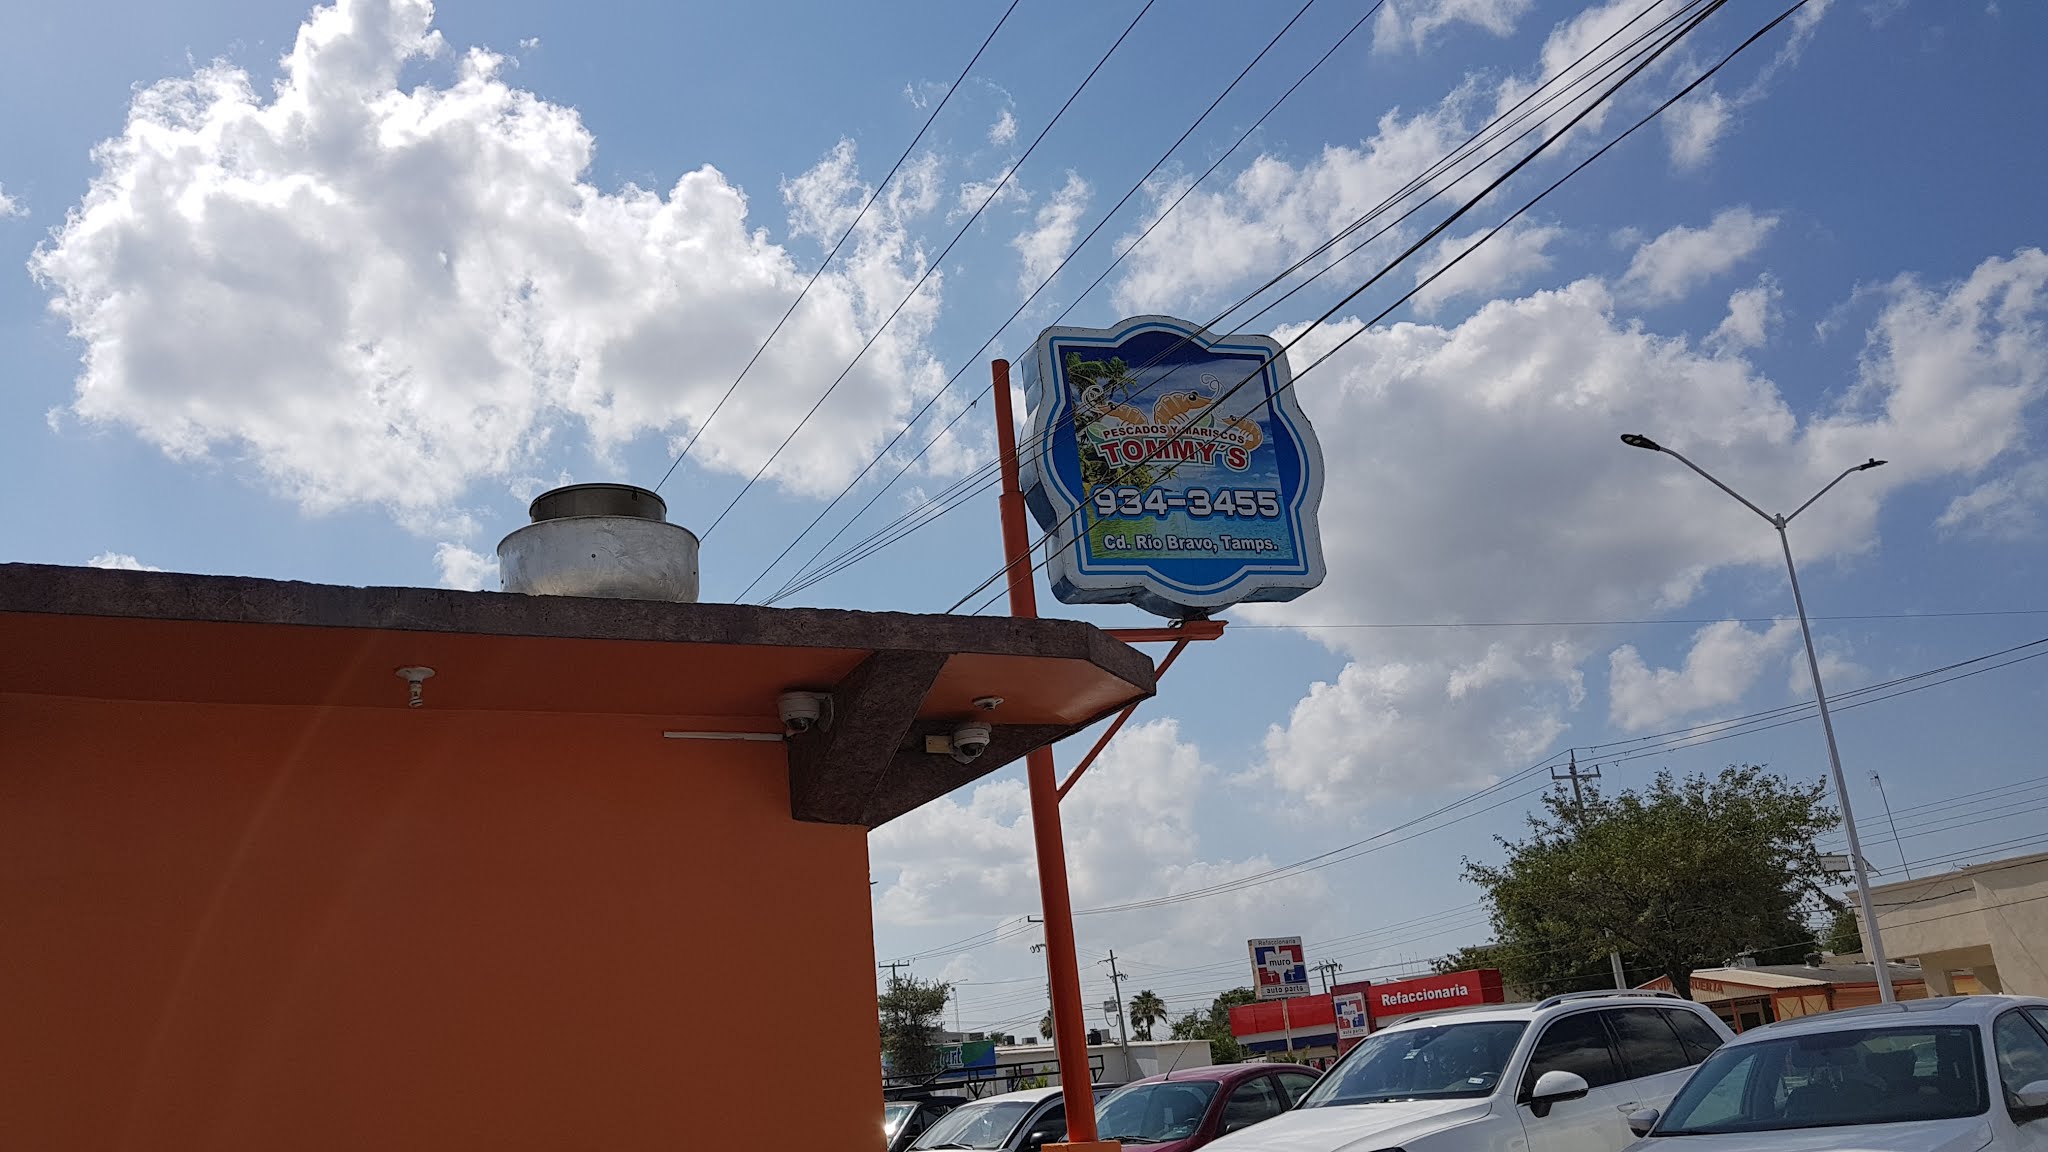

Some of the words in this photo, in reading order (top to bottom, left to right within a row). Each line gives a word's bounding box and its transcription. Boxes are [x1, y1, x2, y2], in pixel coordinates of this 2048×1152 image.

[1103, 426, 1167, 439] PESCADOS
[1171, 426, 1179, 434] Y
[1184, 427, 1245, 444] MARISCOS
[1101, 439, 1247, 468] TOMMY'S
[1094, 488, 1279, 517] 934-3455
[1104, 535, 1131, 550] Cd.
[1136, 535, 1162, 550] Río
[1166, 536, 1218, 552] Bravo,
[1221, 536, 1278, 553] Tamps.
[1270, 959, 1291, 967] muro
[1381, 984, 1468, 1006] Refaccionaria
